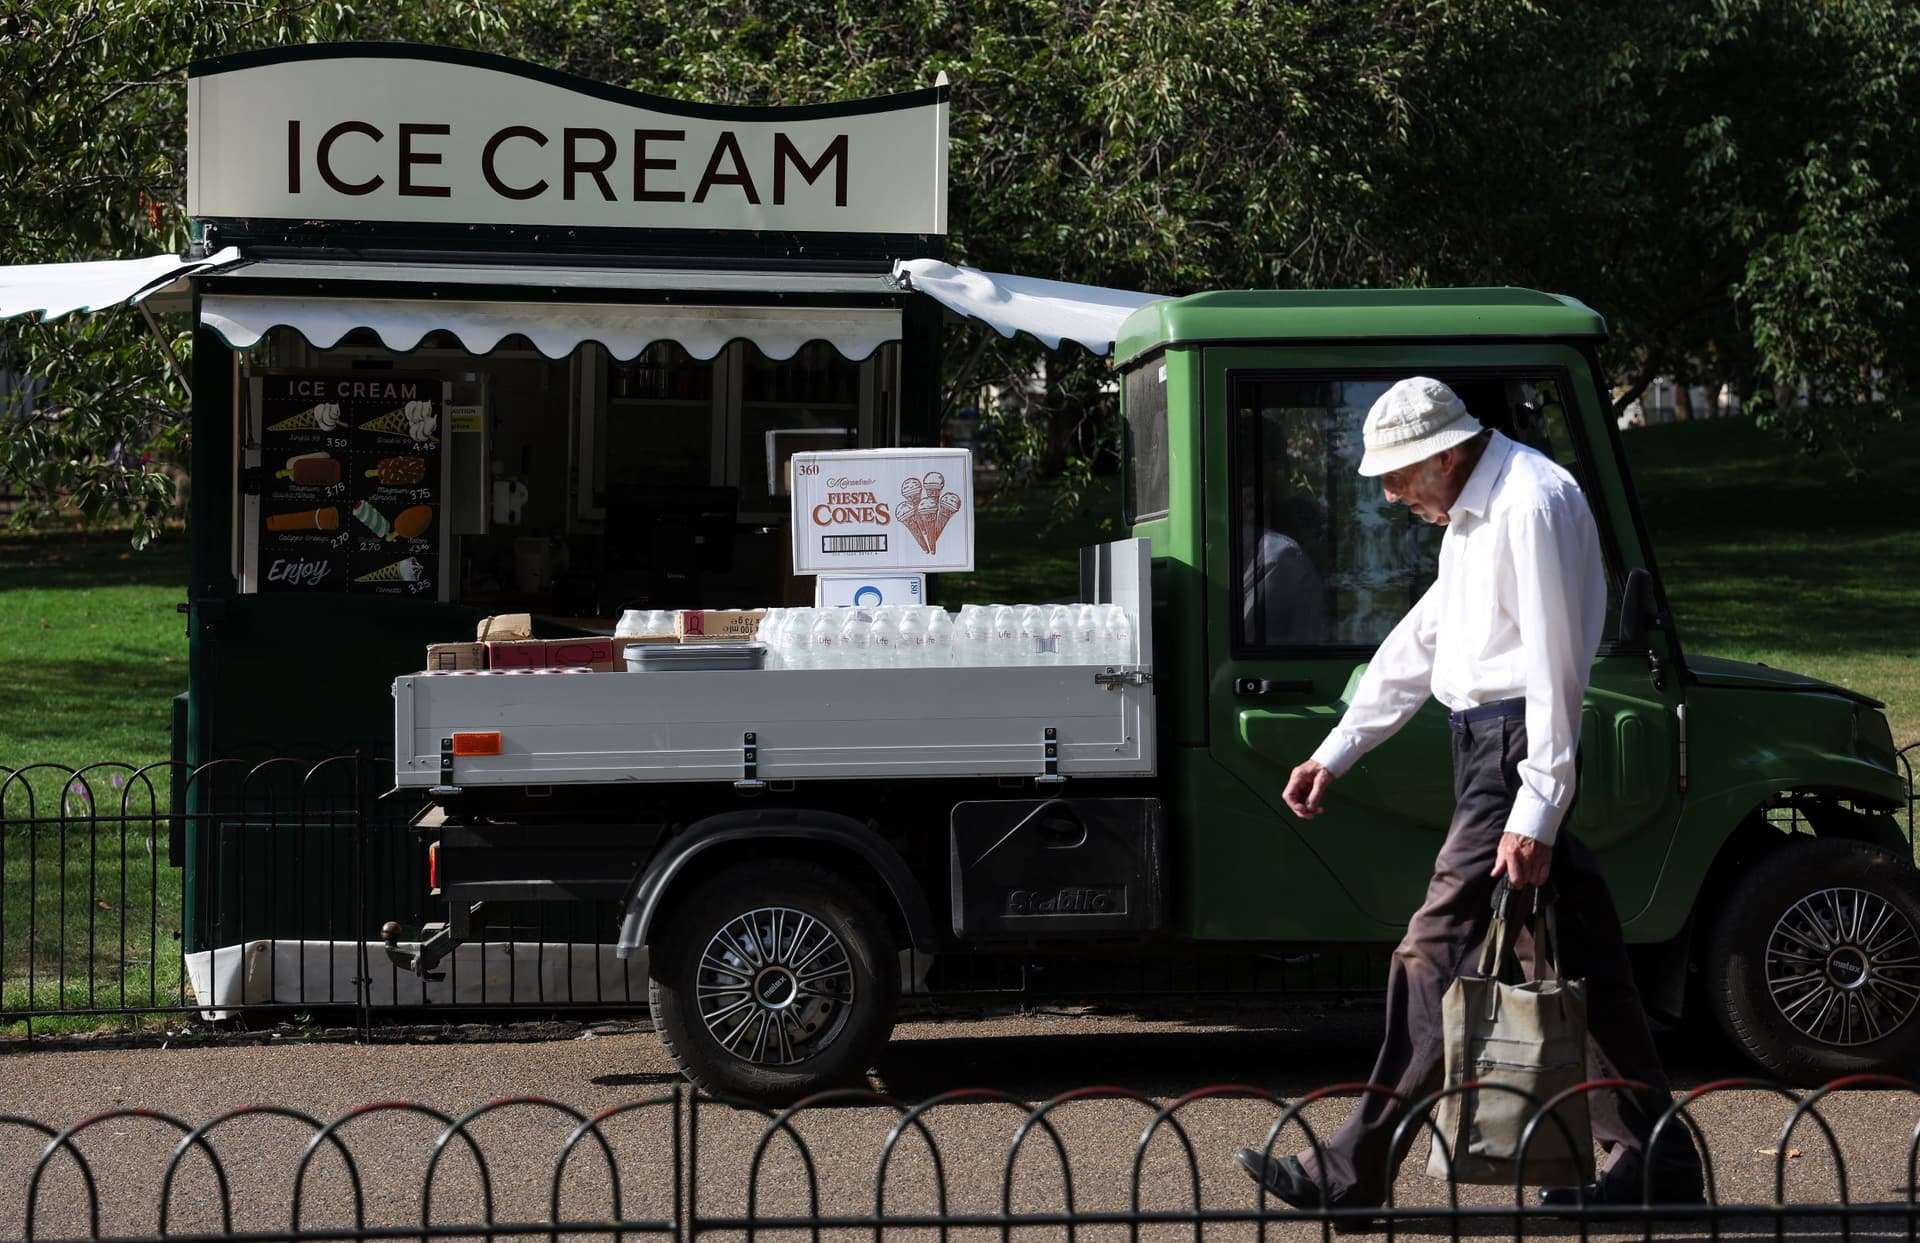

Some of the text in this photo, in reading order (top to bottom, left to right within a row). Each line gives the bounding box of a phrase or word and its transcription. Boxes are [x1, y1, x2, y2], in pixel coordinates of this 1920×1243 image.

[288, 120, 849, 207] ICE CREAM
[289, 380, 417, 399] ICE CREAM
[326, 437, 348, 448] 3.50
[412, 442, 436, 452] 4.45
[799, 464, 819, 476] 360
[827, 492, 877, 505] FIESTA
[812, 503, 891, 527] CONES
[267, 557, 332, 586] Enjoy
[763, 975, 787, 999] melex
